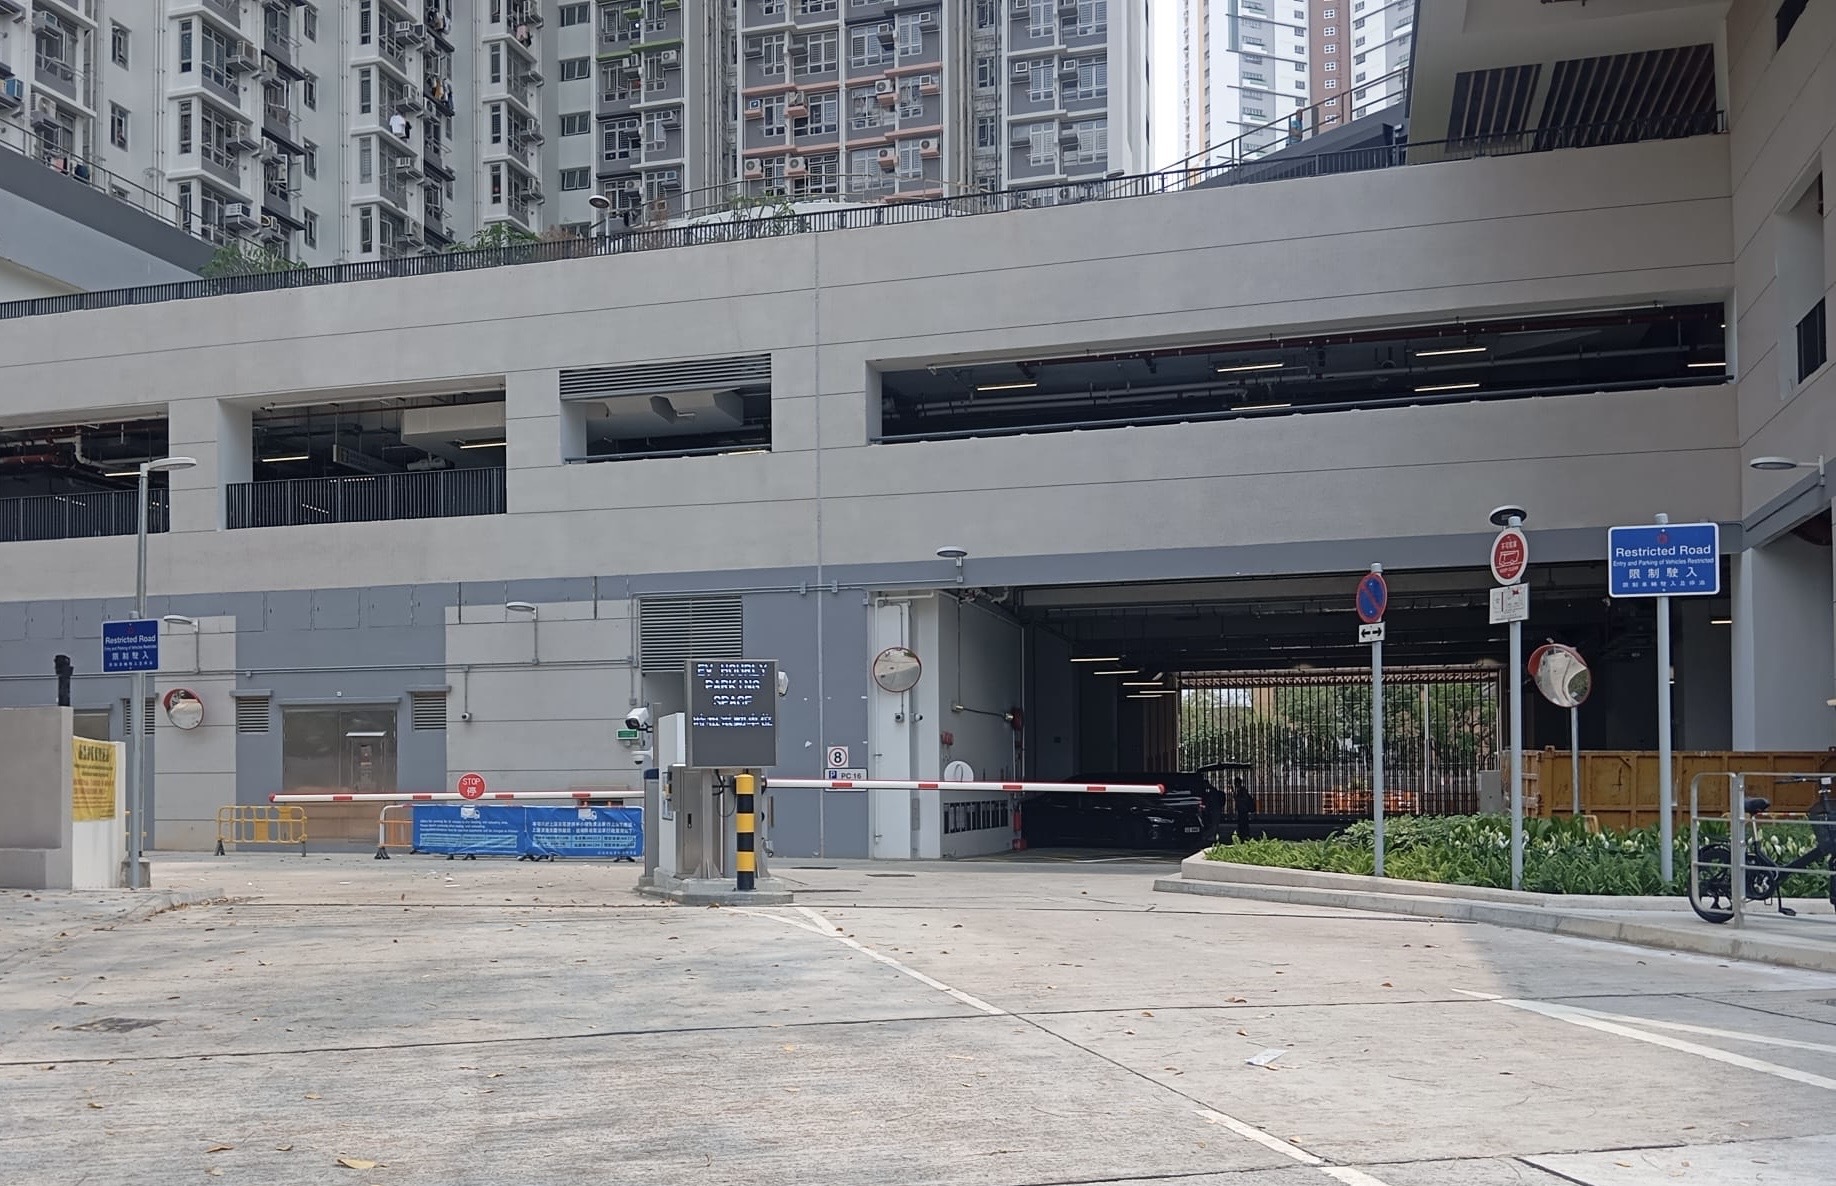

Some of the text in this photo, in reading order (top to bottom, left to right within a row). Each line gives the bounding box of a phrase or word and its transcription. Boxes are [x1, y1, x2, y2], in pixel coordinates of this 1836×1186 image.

[1616, 544, 1711, 557] Restricted Road
[1628, 566, 1698, 579] 限制駛入
[105, 636, 138, 644] Restricted
[697, 663, 768, 677] EV HOURLY
[705, 679, 760, 689] PARKING
[713, 695, 753, 705] SPACE
[834, 751, 842, 763] 8
[462, 777, 480, 785] STOP
[467, 786, 477, 796] 停
